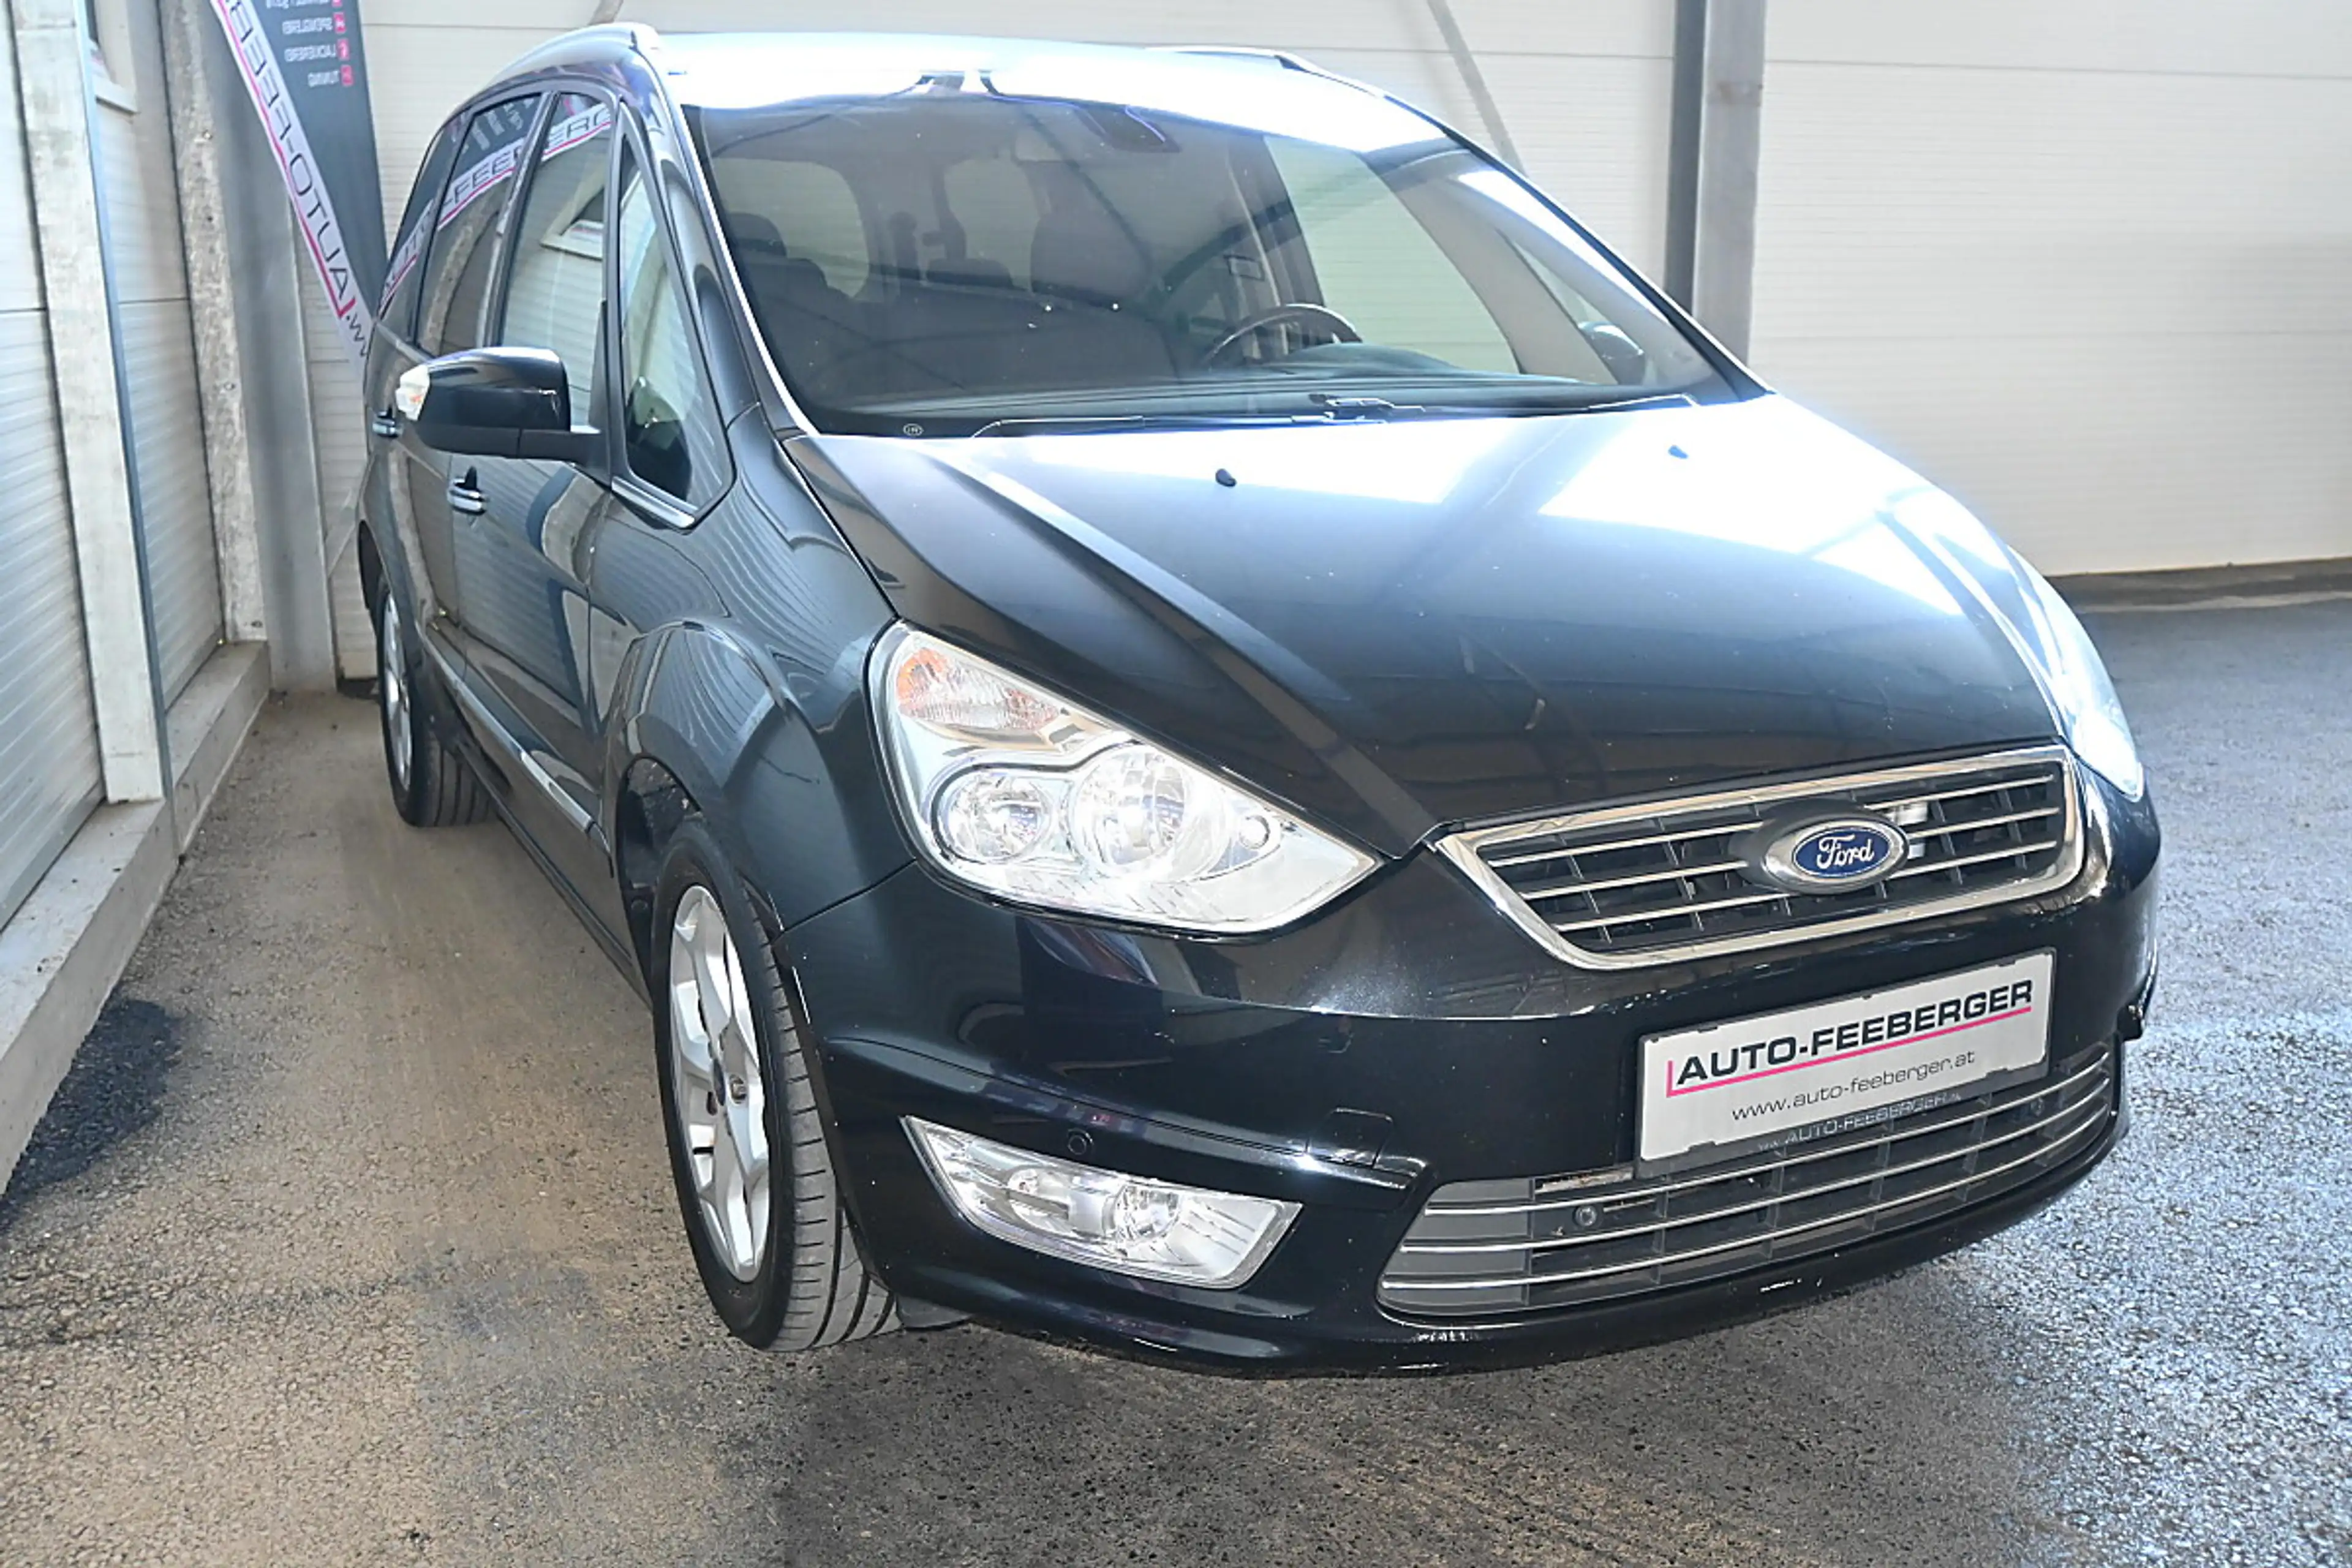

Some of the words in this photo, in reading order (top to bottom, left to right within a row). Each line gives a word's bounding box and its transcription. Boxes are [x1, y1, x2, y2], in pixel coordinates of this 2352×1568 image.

[1817, 833, 1875, 870] Ford
[1677, 980, 2032, 1085] AUTO-FEEBERGER
[1732, 1051, 1975, 1121] www.auto-feeberger.at
